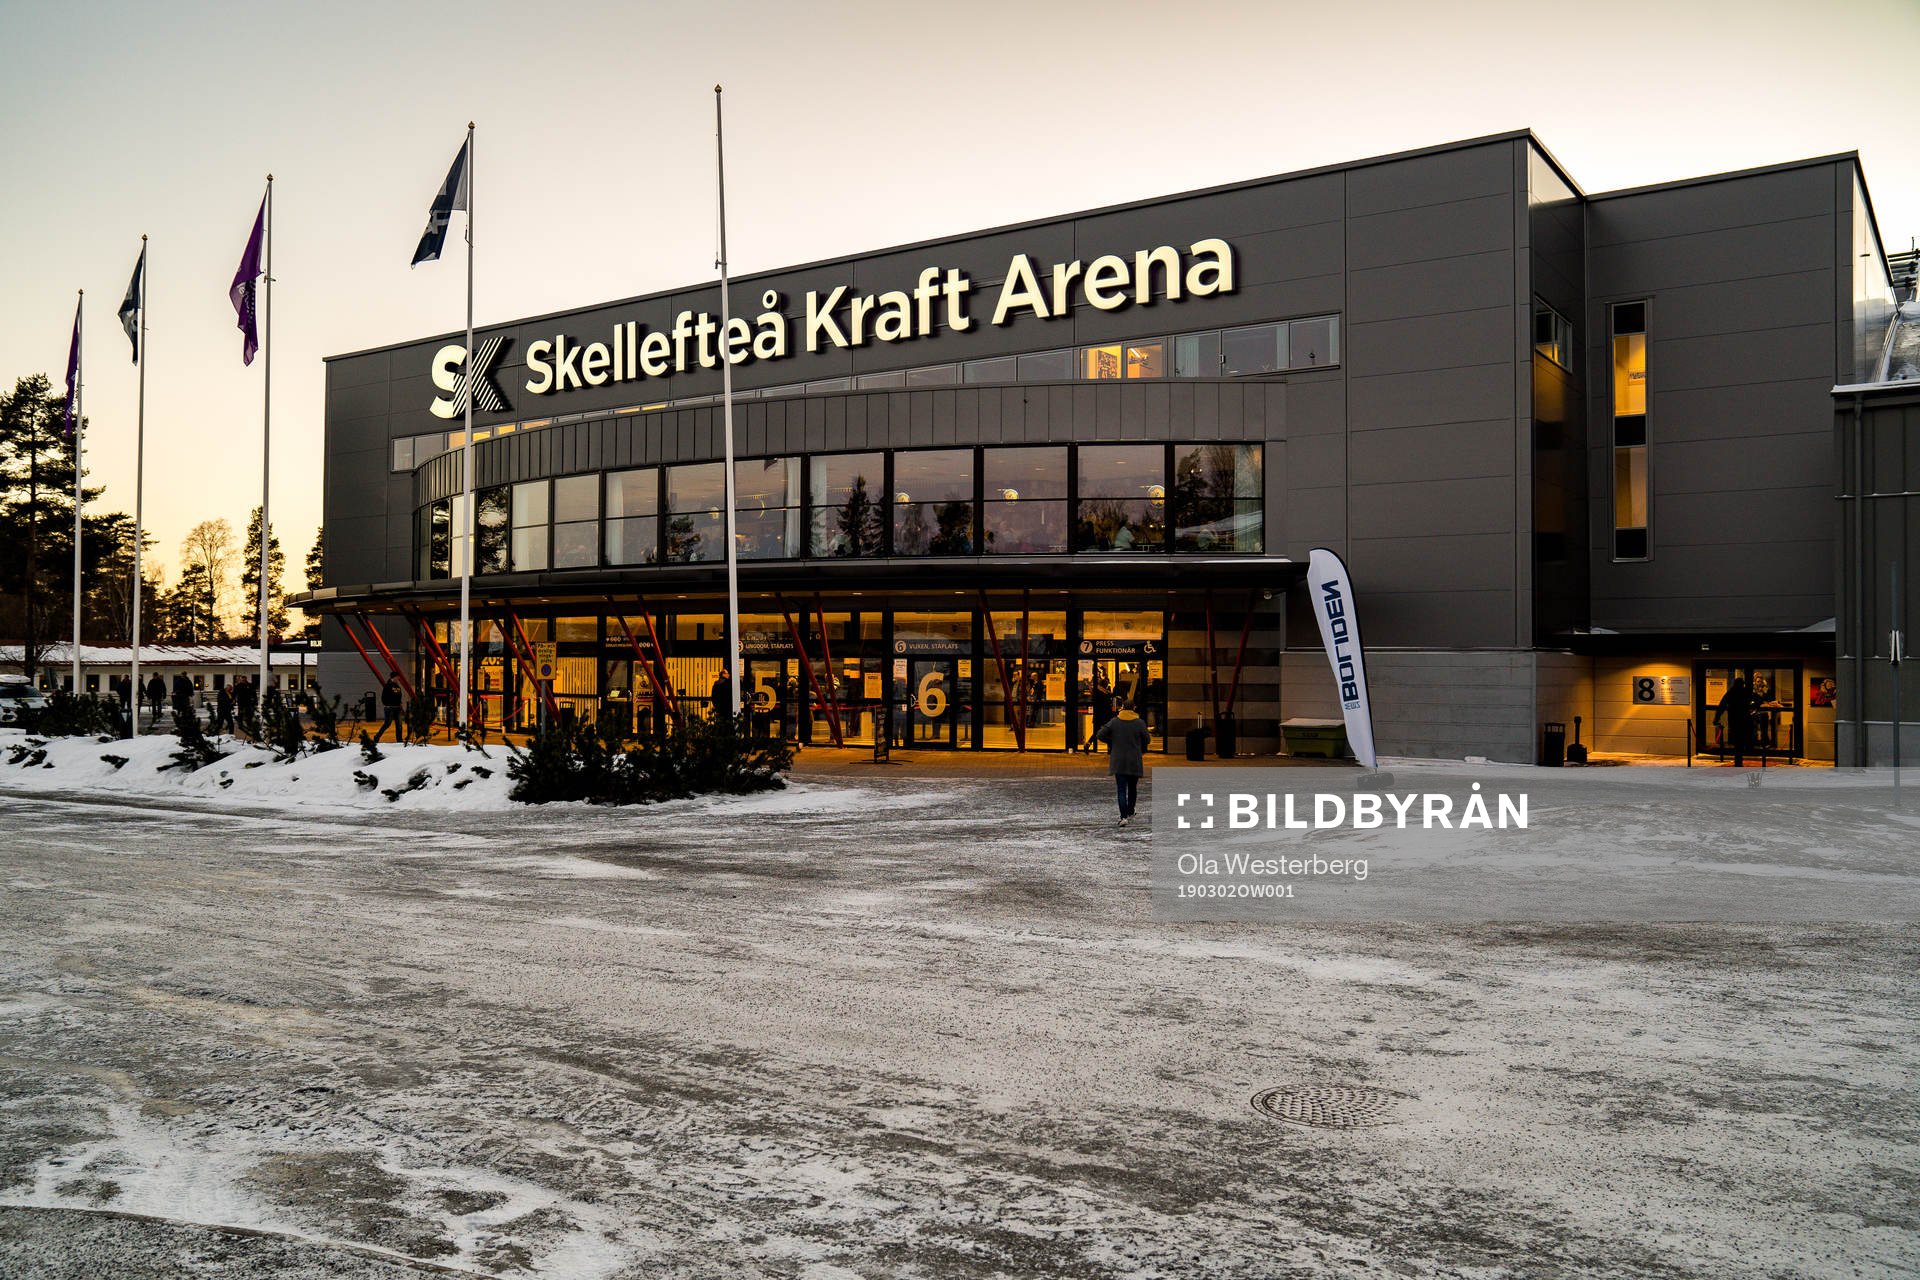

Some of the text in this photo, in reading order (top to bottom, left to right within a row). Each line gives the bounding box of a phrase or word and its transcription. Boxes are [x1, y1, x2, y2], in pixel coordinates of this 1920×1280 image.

[525, 238, 1234, 396] Skellefteå Kraft Arena
[754, 670, 777, 712] 5
[918, 671, 946, 718] 6
[1638, 678, 1656, 702] 8
